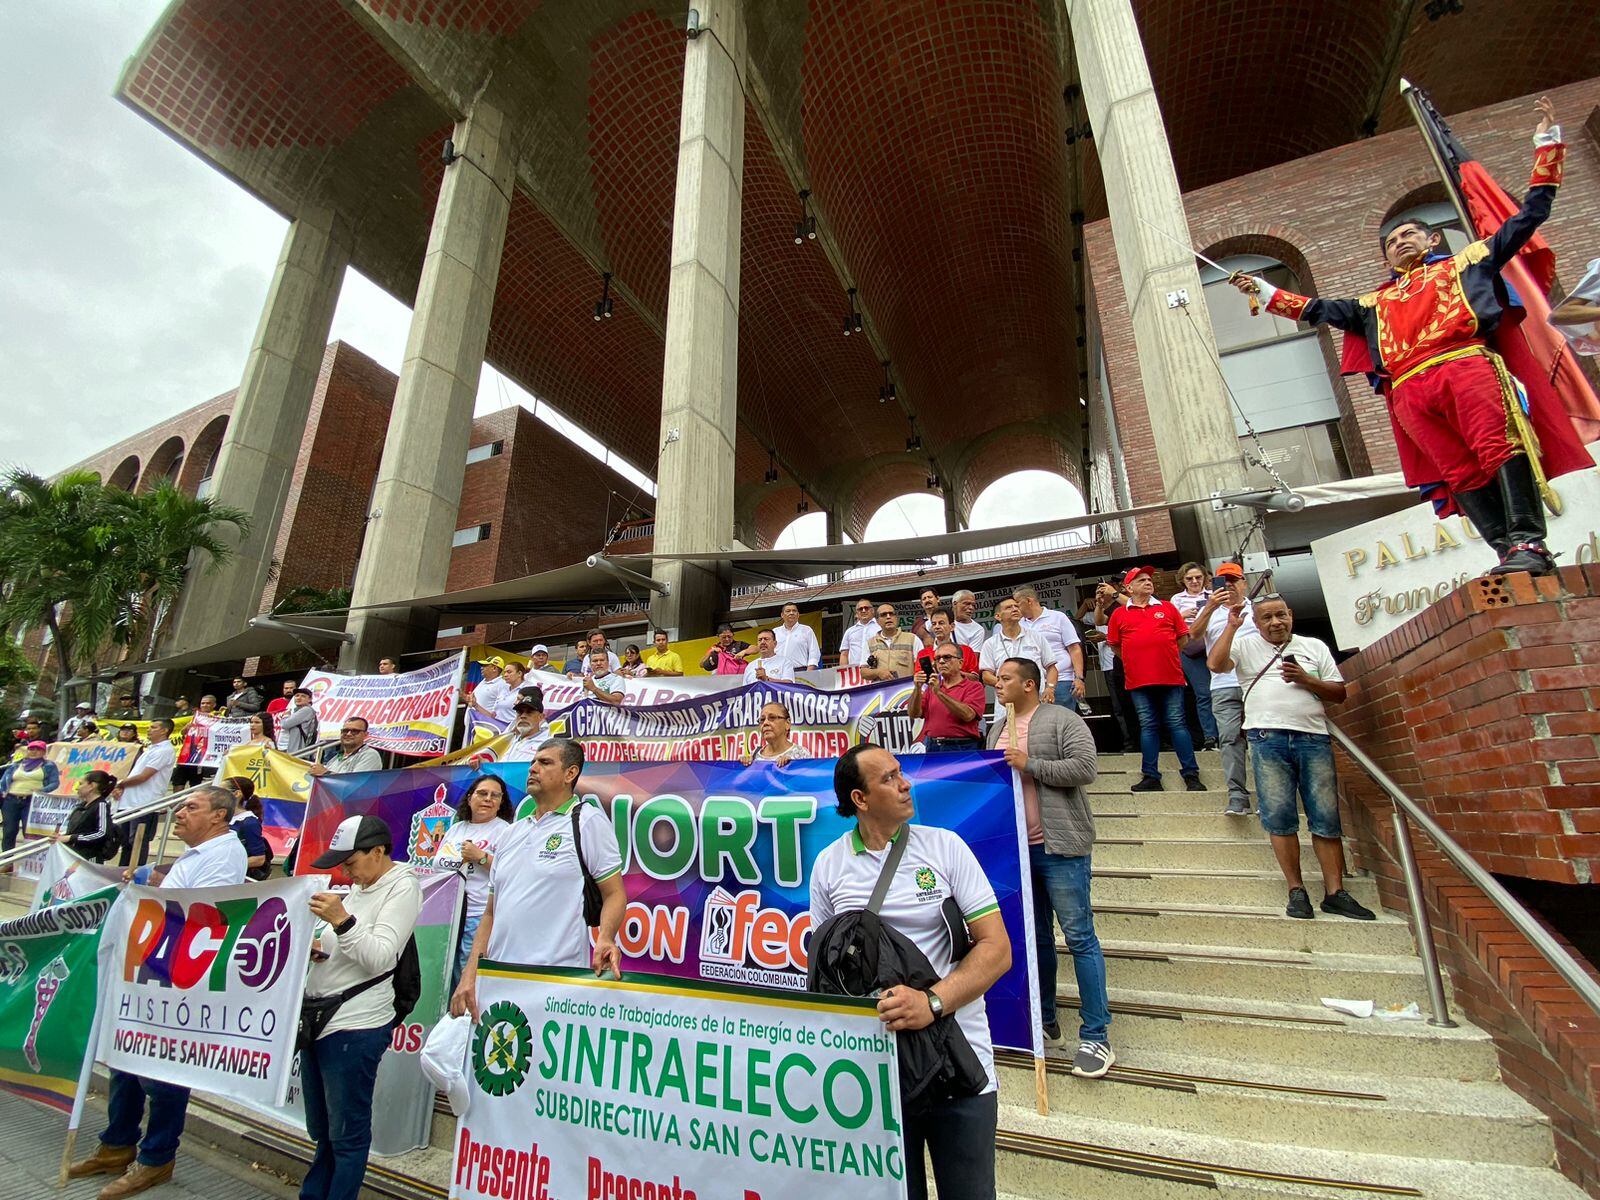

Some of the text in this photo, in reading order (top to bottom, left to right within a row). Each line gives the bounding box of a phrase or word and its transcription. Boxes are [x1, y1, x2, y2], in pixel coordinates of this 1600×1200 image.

[1053, 578, 1070, 588] DEL
[317, 686, 454, 725] SINTRACOPRODIS
[576, 705, 632, 737] CENTRAL
[635, 707, 701, 737] UNITARIA
[702, 701, 724, 733] DE
[750, 730, 850, 760] SANDER
[748, 970, 799, 987] COLOMBIANA
[119, 994, 276, 1037] HISTÓRICO
[545, 996, 597, 1017] Sindicato
[600, 1002, 616, 1019] de
[620, 1004, 697, 1029] Trabajadores
[702, 1015, 719, 1033] de
[722, 1016, 735, 1035] la
[739, 1018, 792, 1045] Energía
[796, 1026, 816, 1046] de
[114, 1029, 157, 1058] NORTE
[159, 1037, 178, 1062] DE
[180, 1040, 271, 1080] SANTANDER
[538, 1019, 901, 1137] SINTRAELECOL
[535, 1088, 904, 1181] SUBDIRECTIVA SAN CAYETANO
